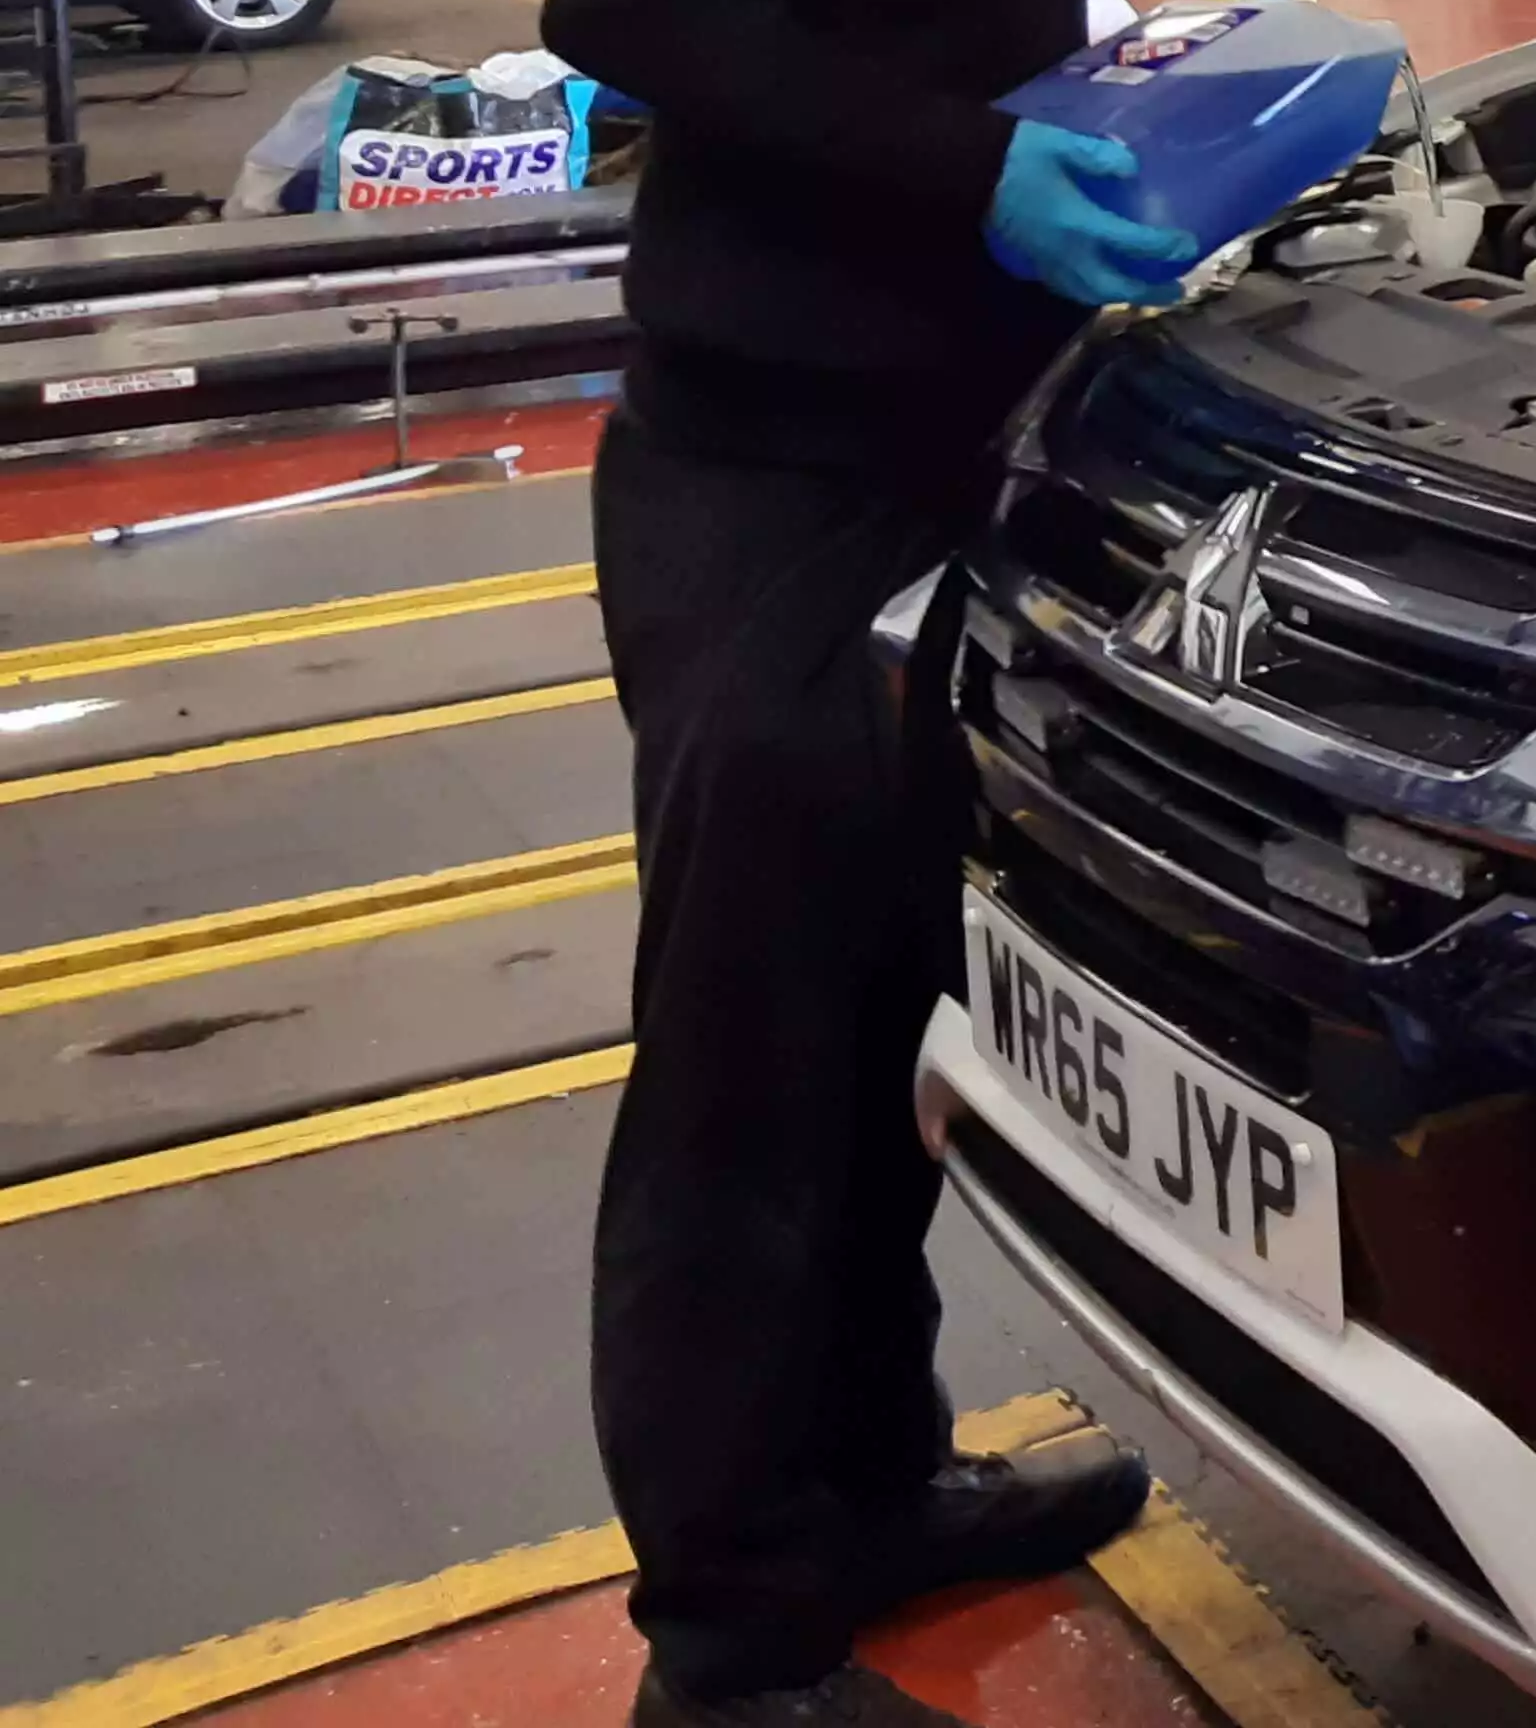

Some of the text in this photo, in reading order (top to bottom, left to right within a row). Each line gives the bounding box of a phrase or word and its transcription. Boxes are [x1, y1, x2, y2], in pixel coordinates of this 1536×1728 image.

[351, 140, 559, 185] SPORTS
[985, 924, 1297, 1261] WR65 JYP
